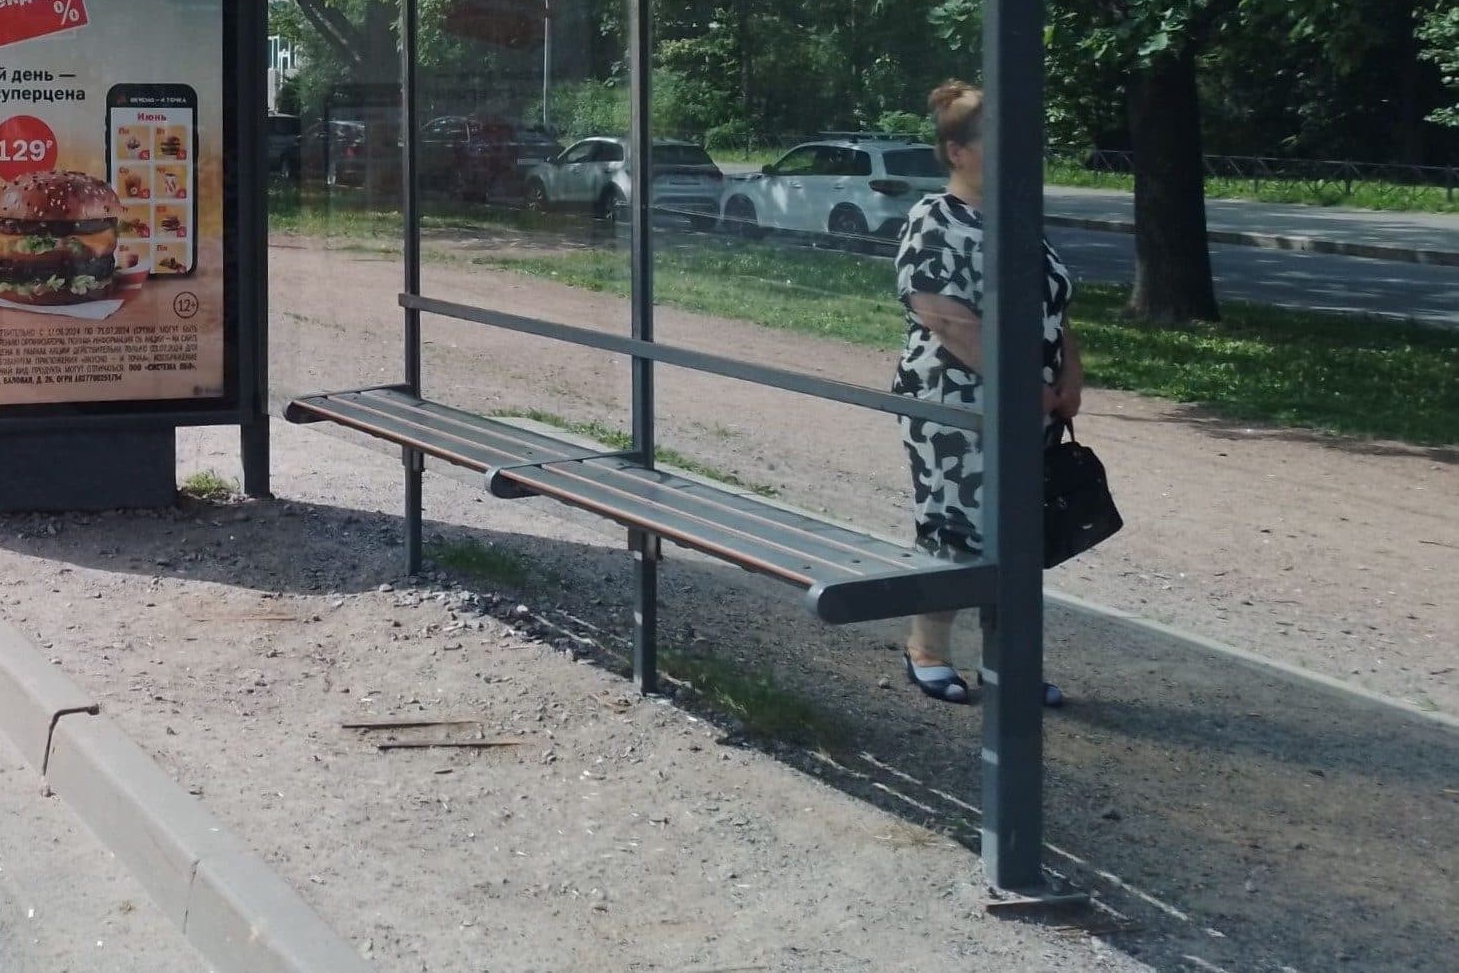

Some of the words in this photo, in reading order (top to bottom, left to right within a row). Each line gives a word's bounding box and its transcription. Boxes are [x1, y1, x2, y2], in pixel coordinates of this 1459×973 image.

[12, 69, 54, 83] день
[137, 112, 167, 122] Июнь
[178, 299, 196, 312] 12+
